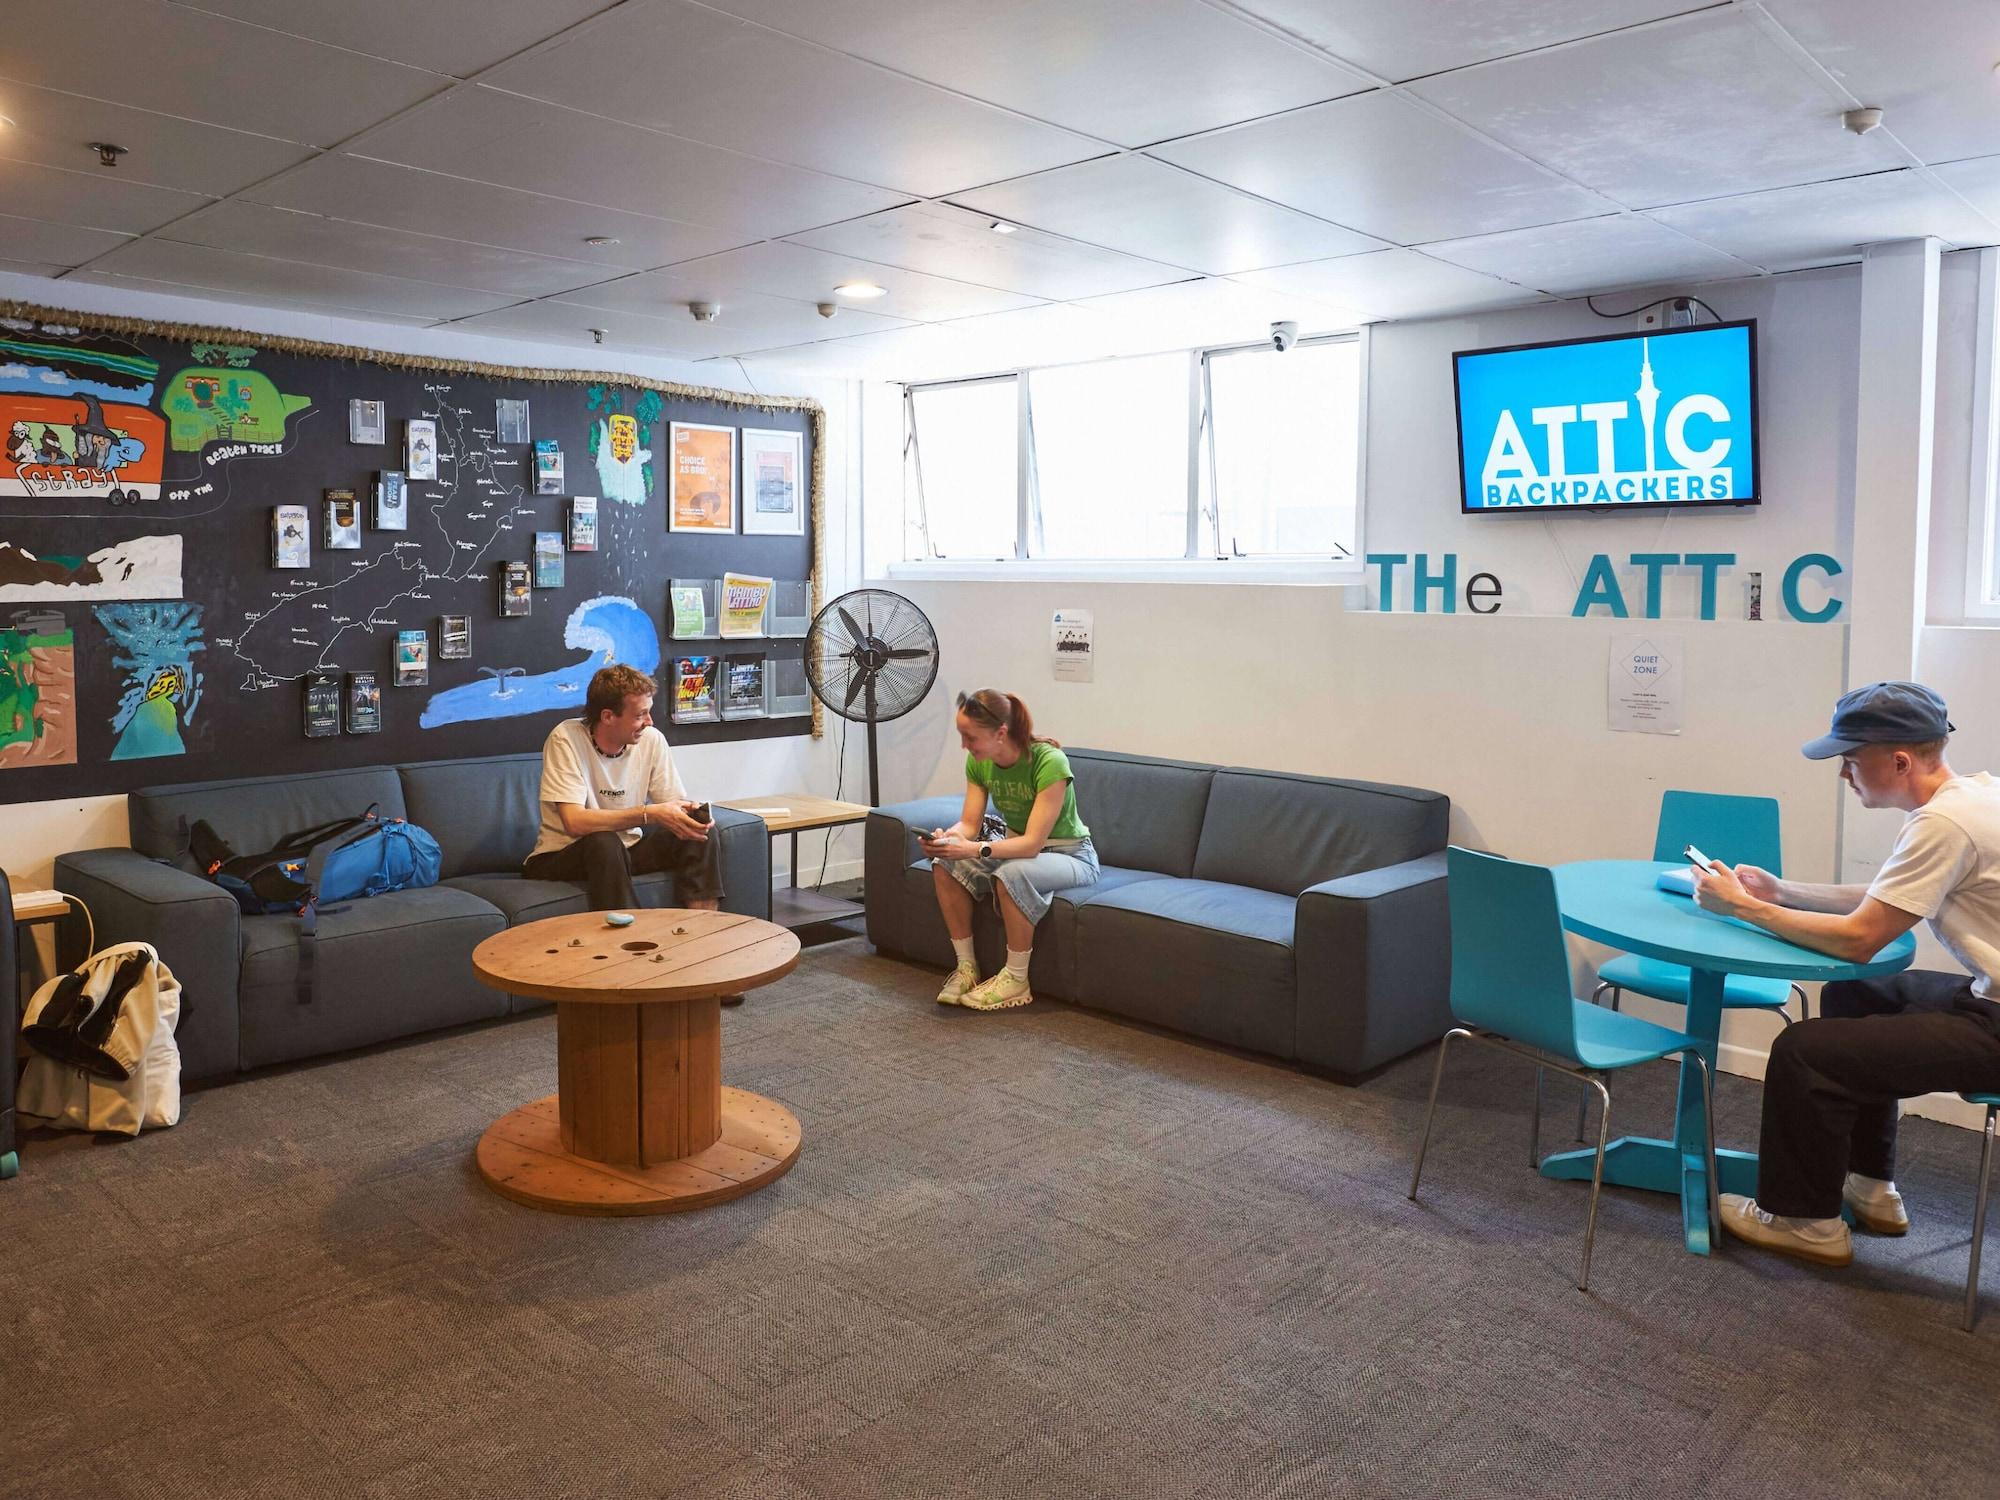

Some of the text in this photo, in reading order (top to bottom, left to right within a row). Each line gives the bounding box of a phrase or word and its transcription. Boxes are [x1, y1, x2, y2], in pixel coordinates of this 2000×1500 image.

[1482, 337, 1732, 479] ATTIC
[679, 455, 706, 466] CHOICE
[679, 465, 690, 474] AS
[1487, 474, 1728, 506] BACKPACKERS
[727, 595, 763, 610] LATINO
[1633, 655, 1658, 664] QUIET
[1633, 665, 1658, 674] ZONE
[1004, 781, 1034, 800] JEAN
